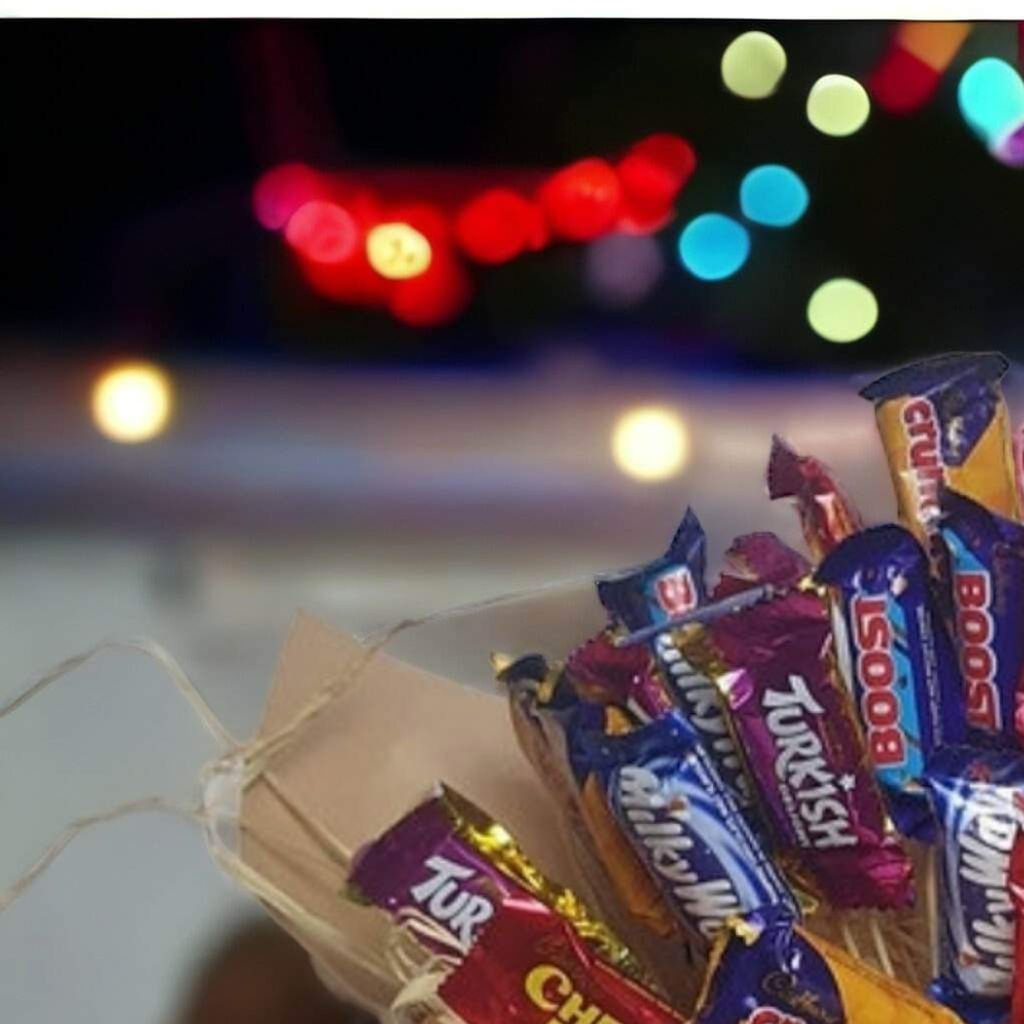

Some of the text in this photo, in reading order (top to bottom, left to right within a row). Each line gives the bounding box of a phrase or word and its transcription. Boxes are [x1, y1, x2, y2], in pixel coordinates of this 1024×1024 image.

[852, 593, 908, 768] BOOST
[955, 571, 1002, 732] BOOST
[761, 674, 859, 848] TURKISH
